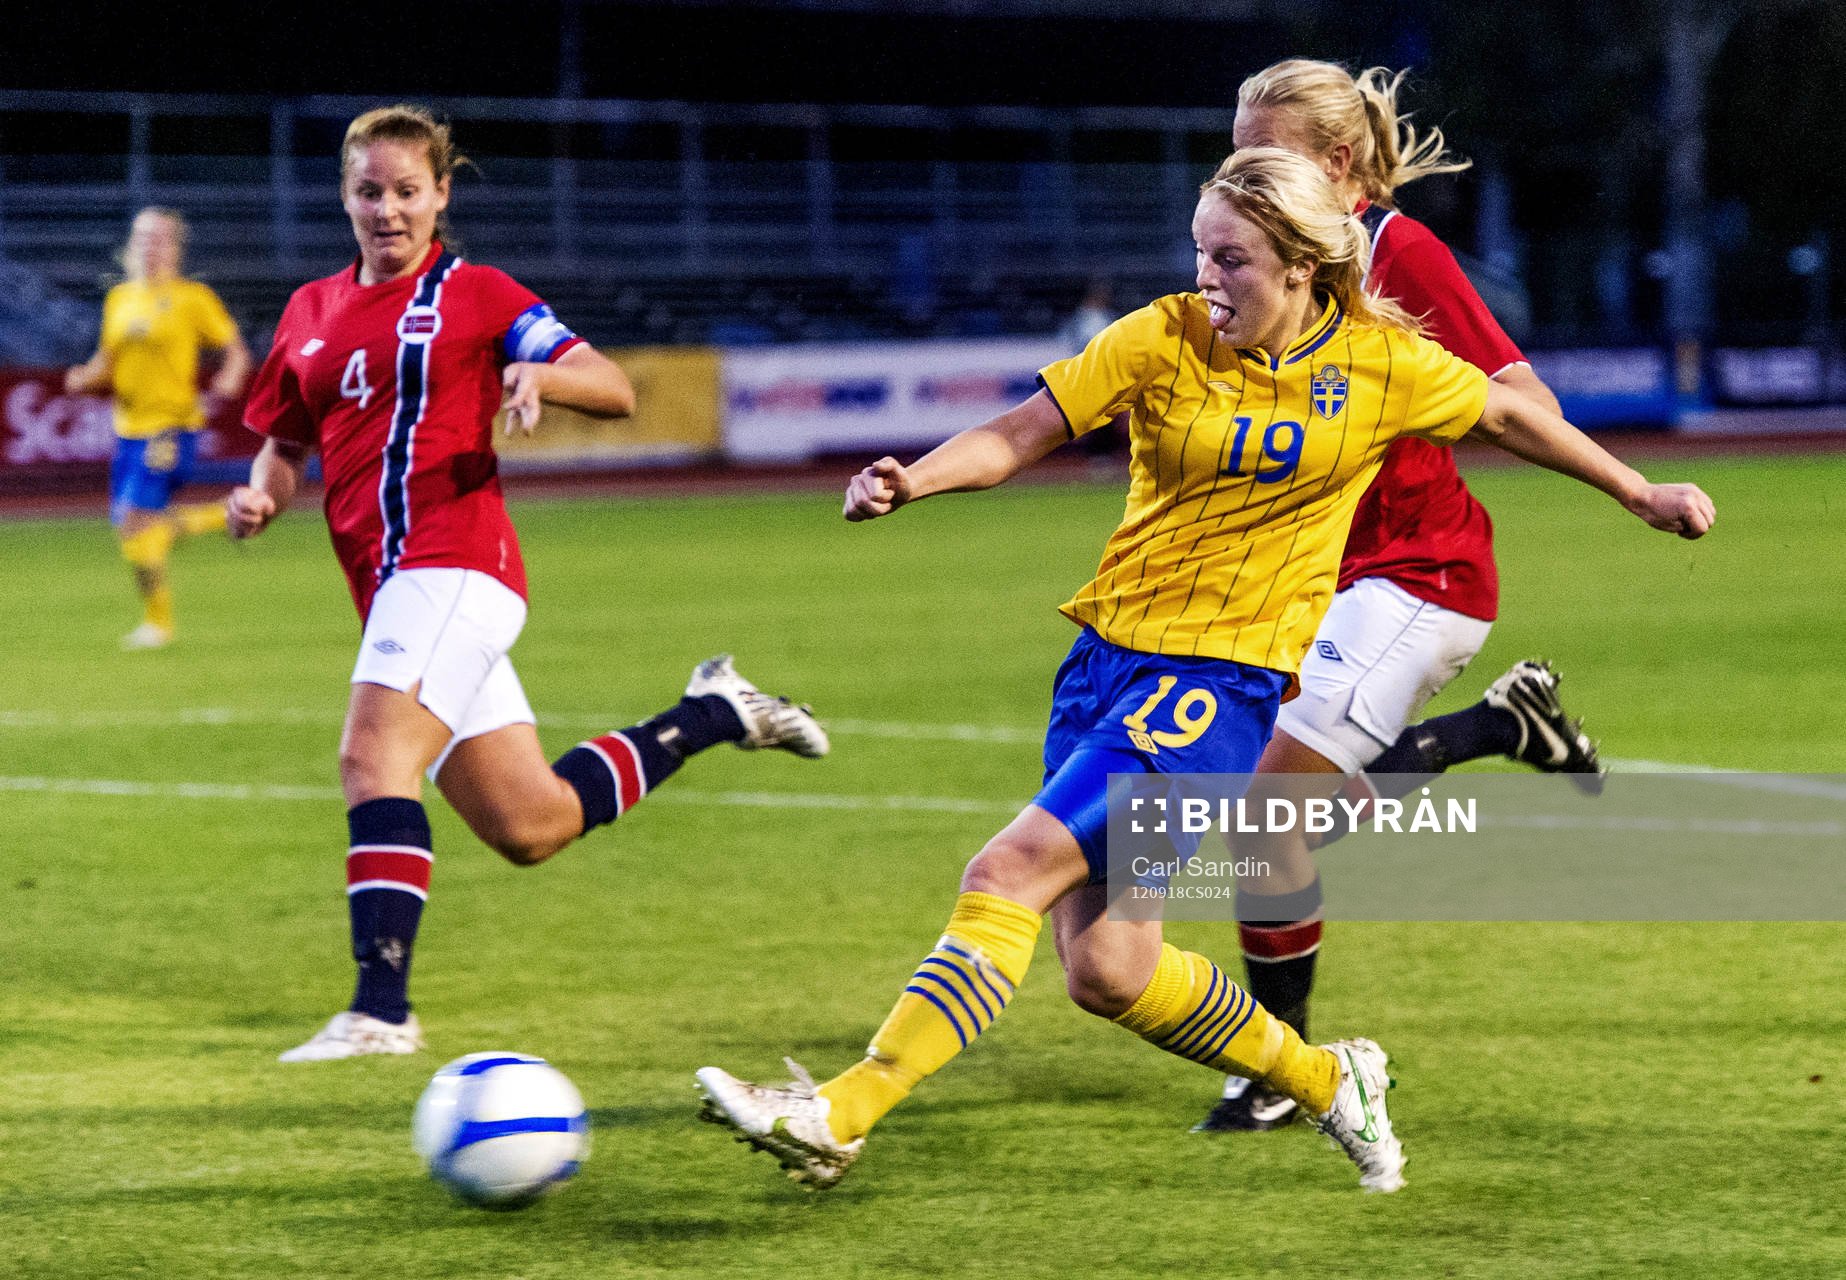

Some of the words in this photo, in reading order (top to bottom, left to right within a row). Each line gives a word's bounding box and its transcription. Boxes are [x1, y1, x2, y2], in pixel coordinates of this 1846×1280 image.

[340, 349, 375, 410] 4
[1220, 416, 1304, 484] 19
[1122, 675, 1218, 749] 19
